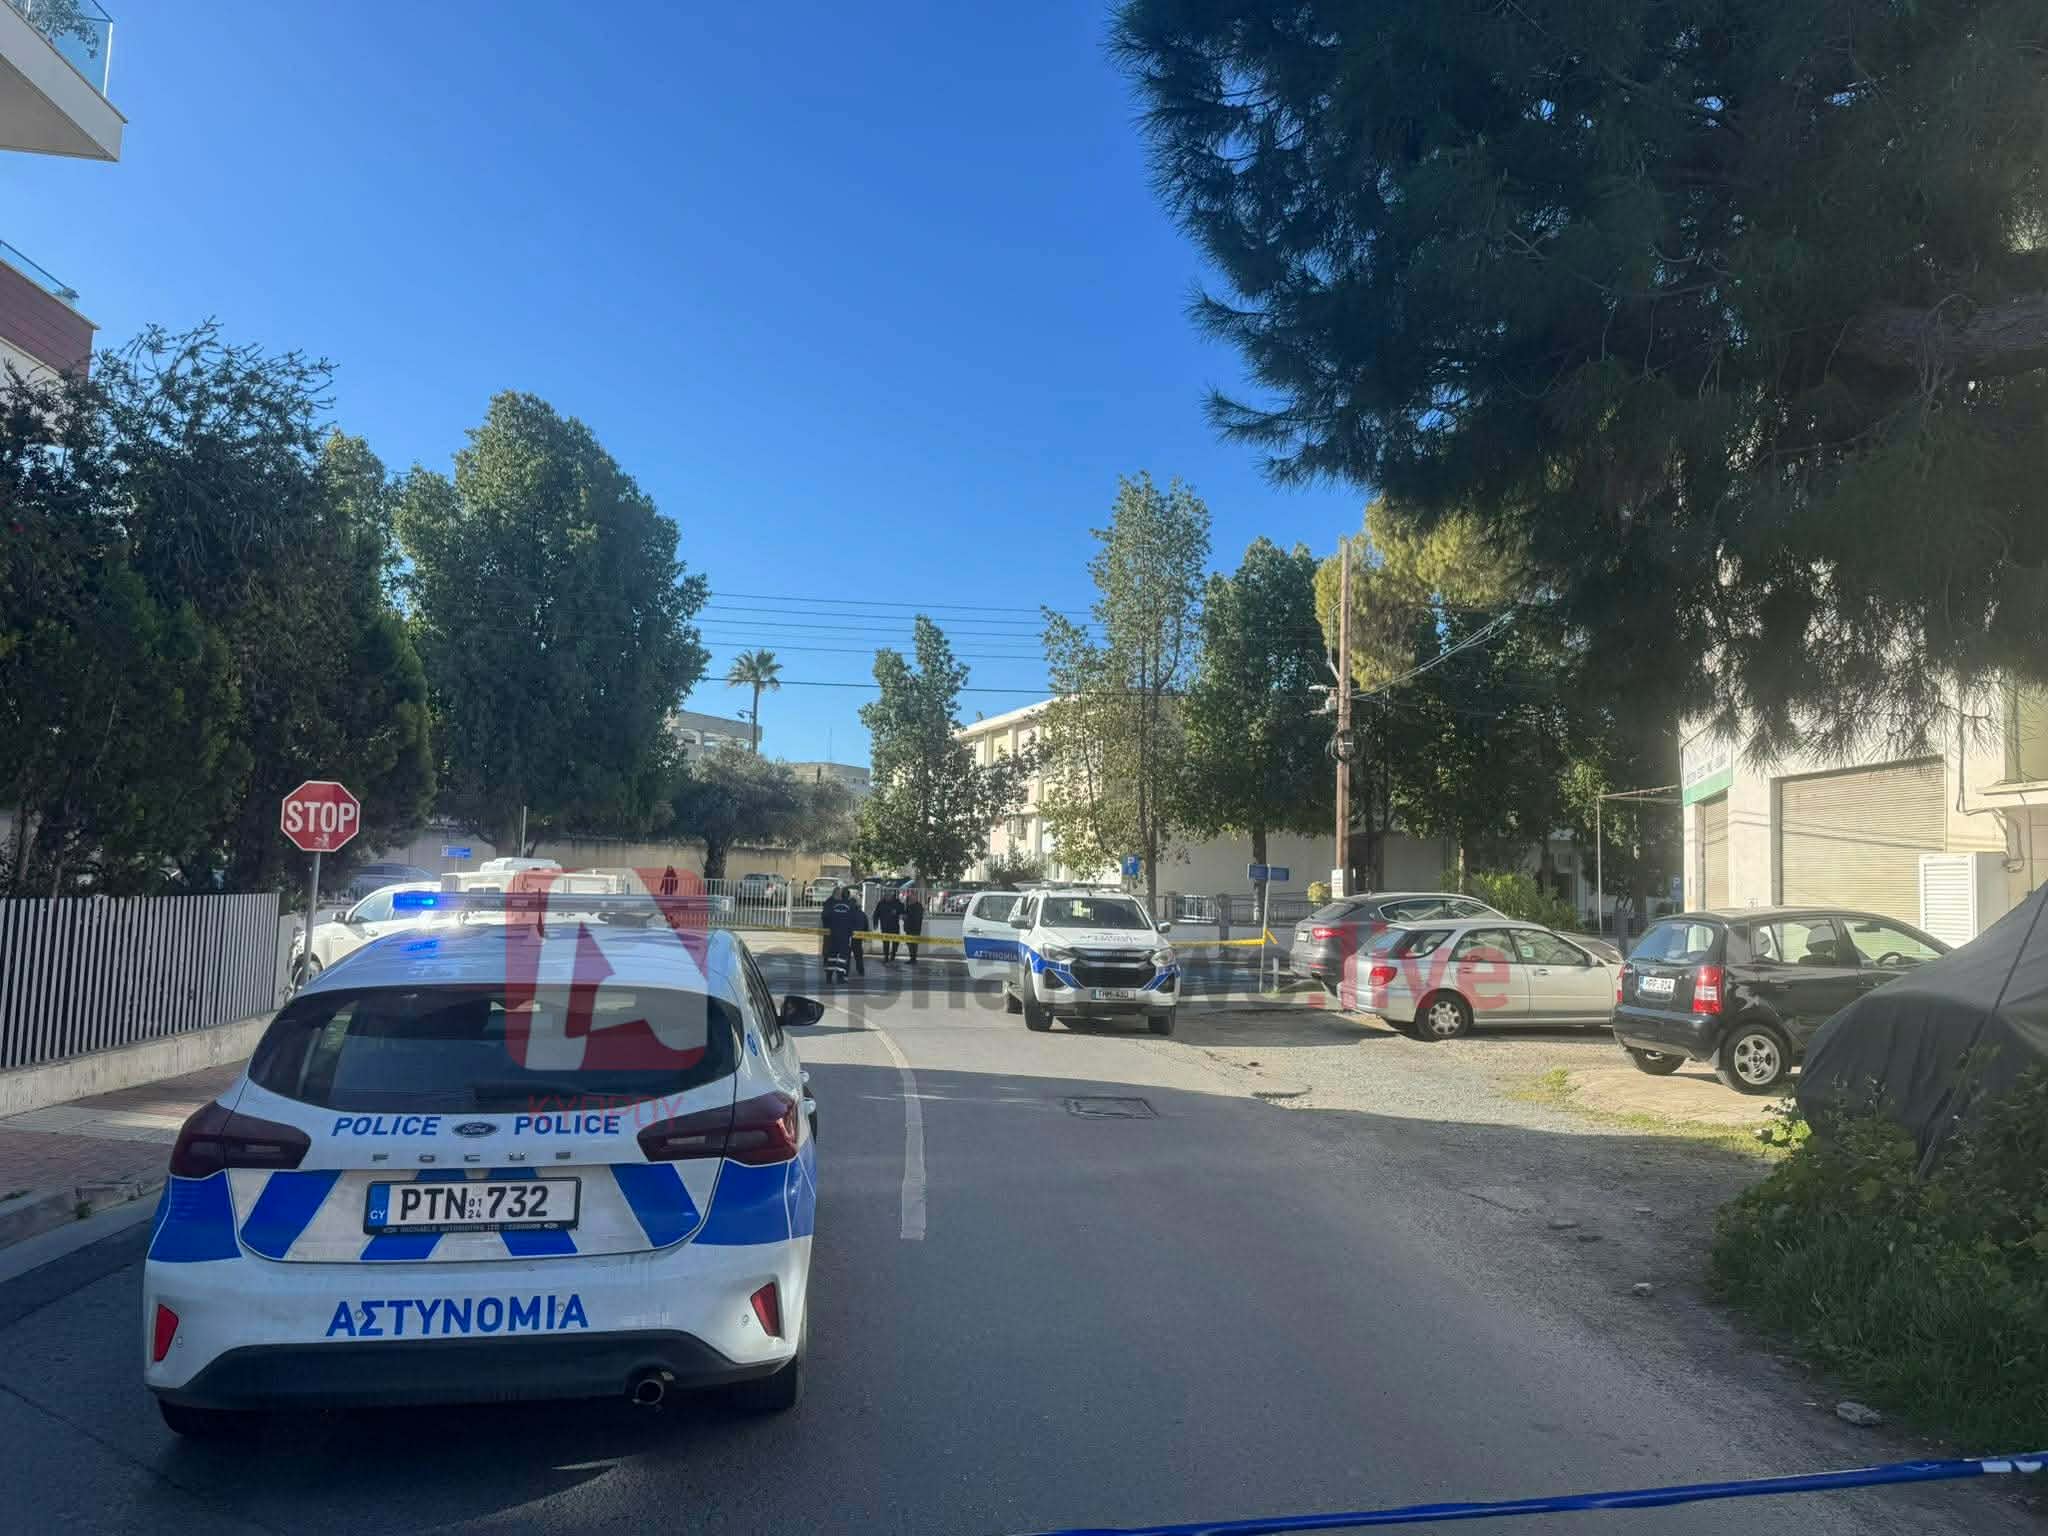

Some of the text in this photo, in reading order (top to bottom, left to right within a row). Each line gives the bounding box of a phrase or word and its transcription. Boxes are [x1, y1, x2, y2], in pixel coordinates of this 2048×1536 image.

[286, 800, 356, 833] STOP
[331, 1116, 442, 1137] POLICE
[513, 1115, 621, 1136] POLICE
[372, 1151, 572, 1163] FOCUS
[400, 1185, 549, 1221] PTN 732
[467, 1209, 482, 1219] 24
[325, 1294, 589, 1337] ΑΣΤΥΝΟΜΙΑ
